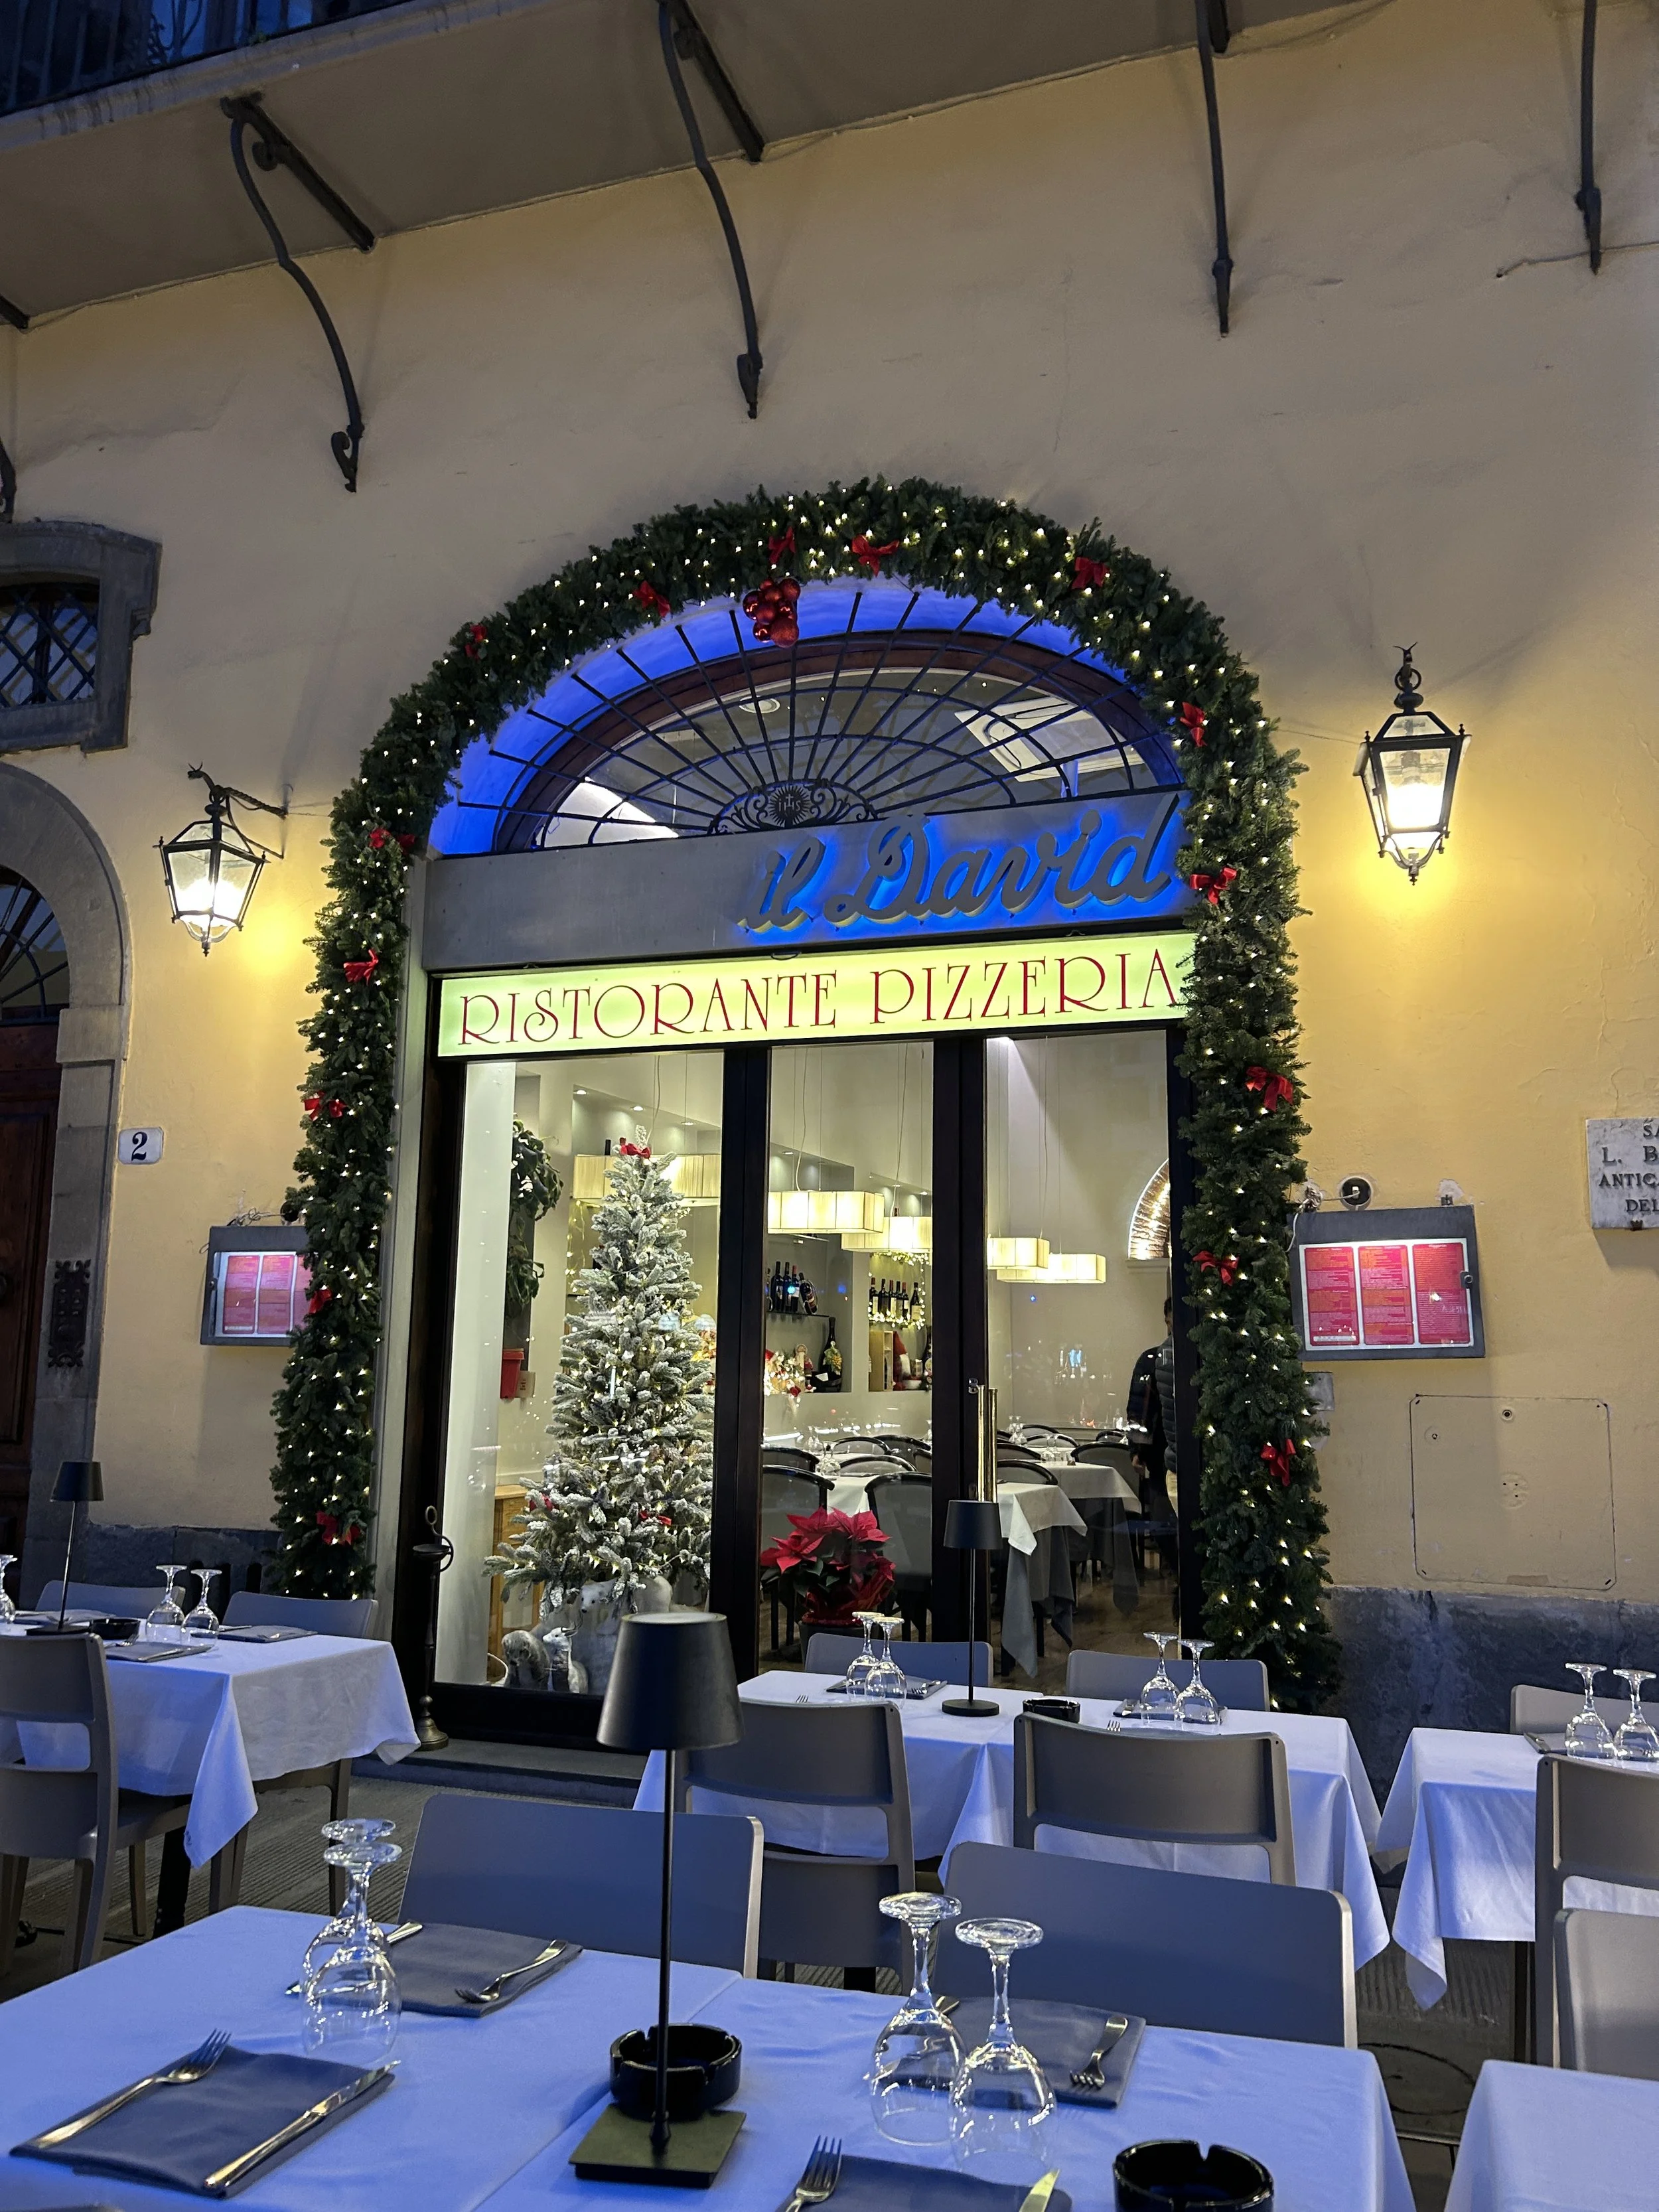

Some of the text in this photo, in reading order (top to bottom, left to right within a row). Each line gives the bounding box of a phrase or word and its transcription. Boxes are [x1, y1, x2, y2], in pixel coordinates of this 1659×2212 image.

[824, 794, 1180, 926] David
[459, 948, 1178, 1045] RISTORANTE PIZZERIA
[131, 1131, 148, 1161] 2
[1602, 1147, 1622, 1163] L.
[1599, 1172, 1659, 1187] ANTIC
